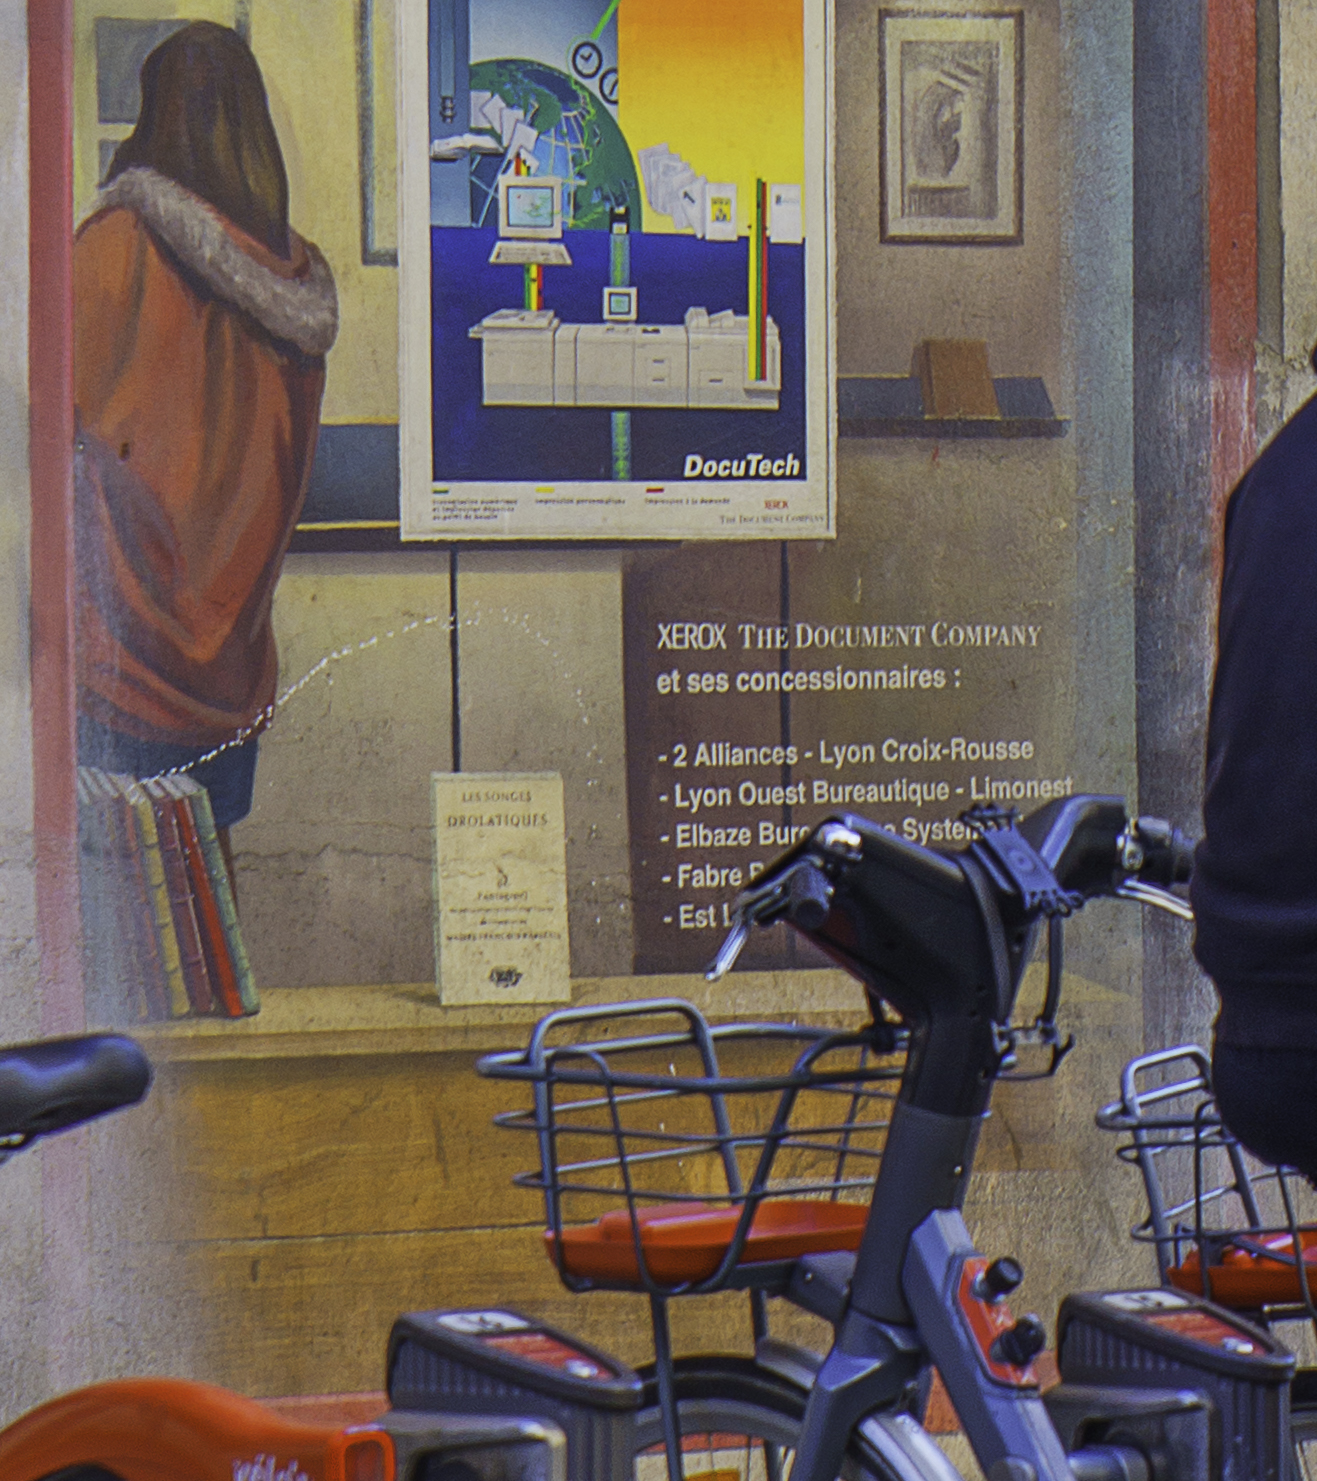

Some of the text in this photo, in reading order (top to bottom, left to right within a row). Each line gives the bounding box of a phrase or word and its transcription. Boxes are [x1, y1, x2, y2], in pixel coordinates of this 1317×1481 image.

[683, 453, 800, 478] DocuTech
[657, 621, 1042, 650] XEROX THE DOCUMENT COMPANY
[657, 665, 946, 694] et ses concessionnaires
[673, 736, 1034, 770] 2 Alliances Lyon Croix-Rousse
[462, 790, 532, 803] LES SONGES
[675, 774, 1074, 813] Lyon Ouest Bureautique Limonest
[448, 814, 548, 828] DROLATIQUES
[677, 822, 752, 848] Elbaze
[678, 863, 742, 888] Fabre
[680, 903, 716, 929] Est
